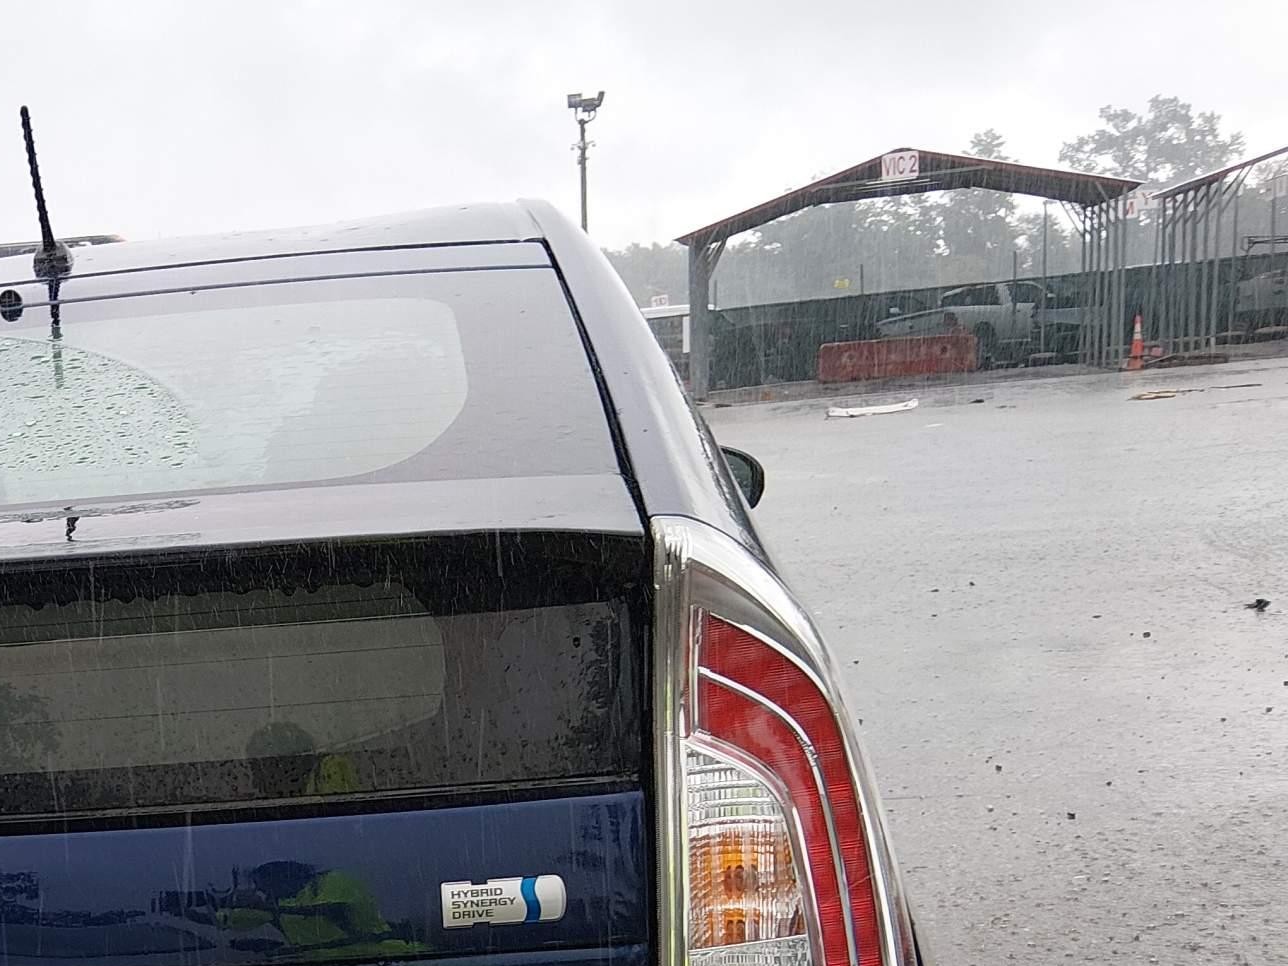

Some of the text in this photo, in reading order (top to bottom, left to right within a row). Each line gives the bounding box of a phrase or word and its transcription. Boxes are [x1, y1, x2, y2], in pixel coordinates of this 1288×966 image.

[882, 155, 918, 177] VIC 2
[450, 887, 503, 900] HYBRID
[451, 897, 516, 910] SYNERGY
[452, 908, 495, 920] DRIVE
